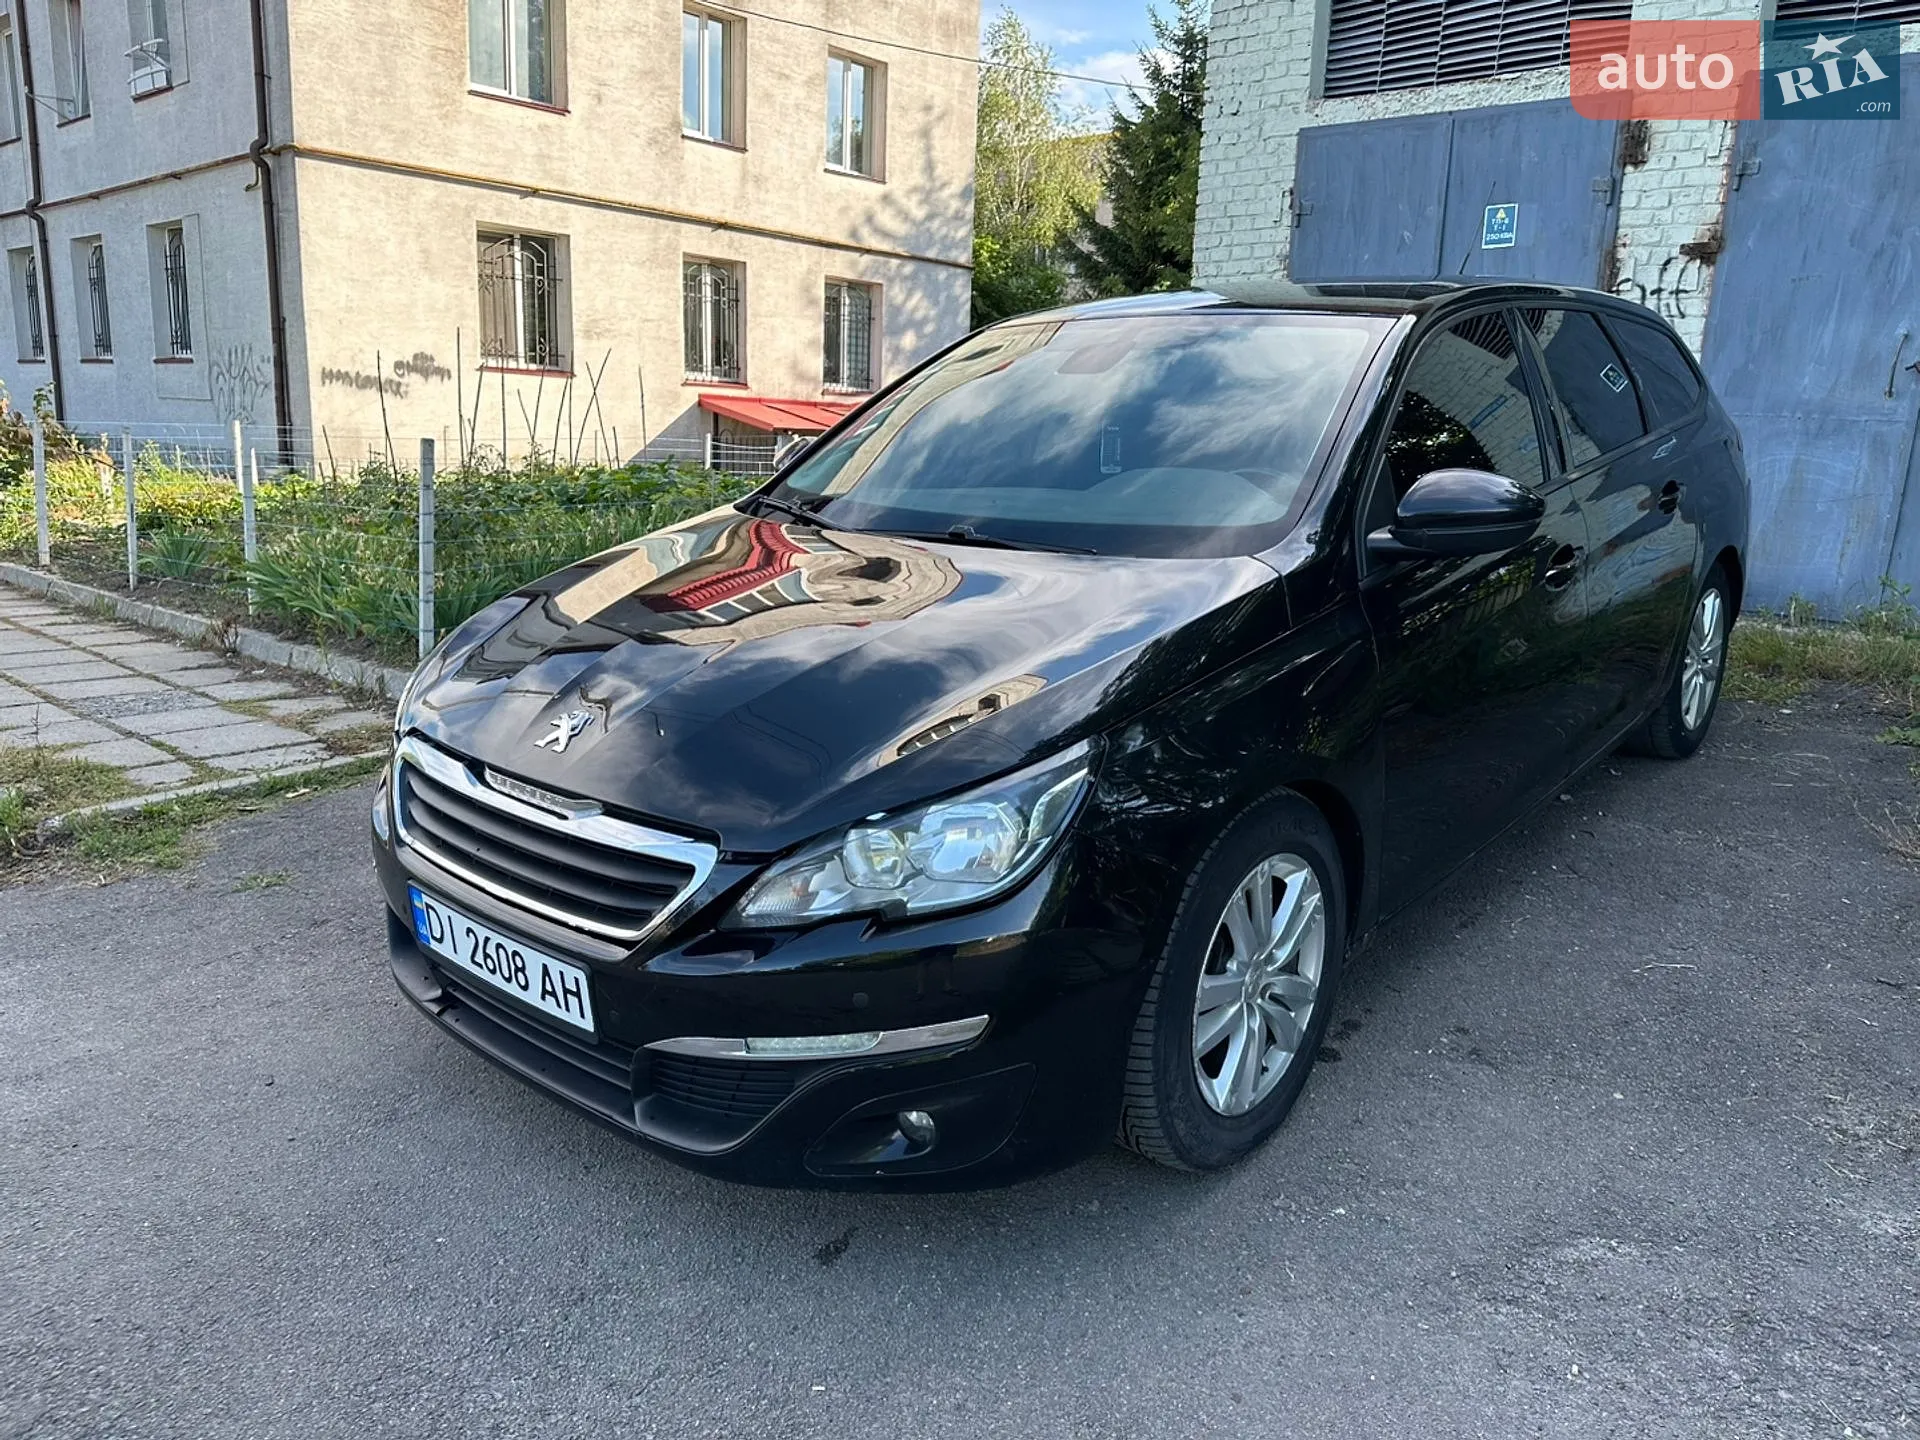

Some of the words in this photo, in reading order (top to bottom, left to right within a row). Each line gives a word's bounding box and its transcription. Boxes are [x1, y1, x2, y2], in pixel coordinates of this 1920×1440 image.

[424, 902, 458, 955] DI
[465, 926, 530, 992] 2608
[540, 962, 586, 1020] AH
